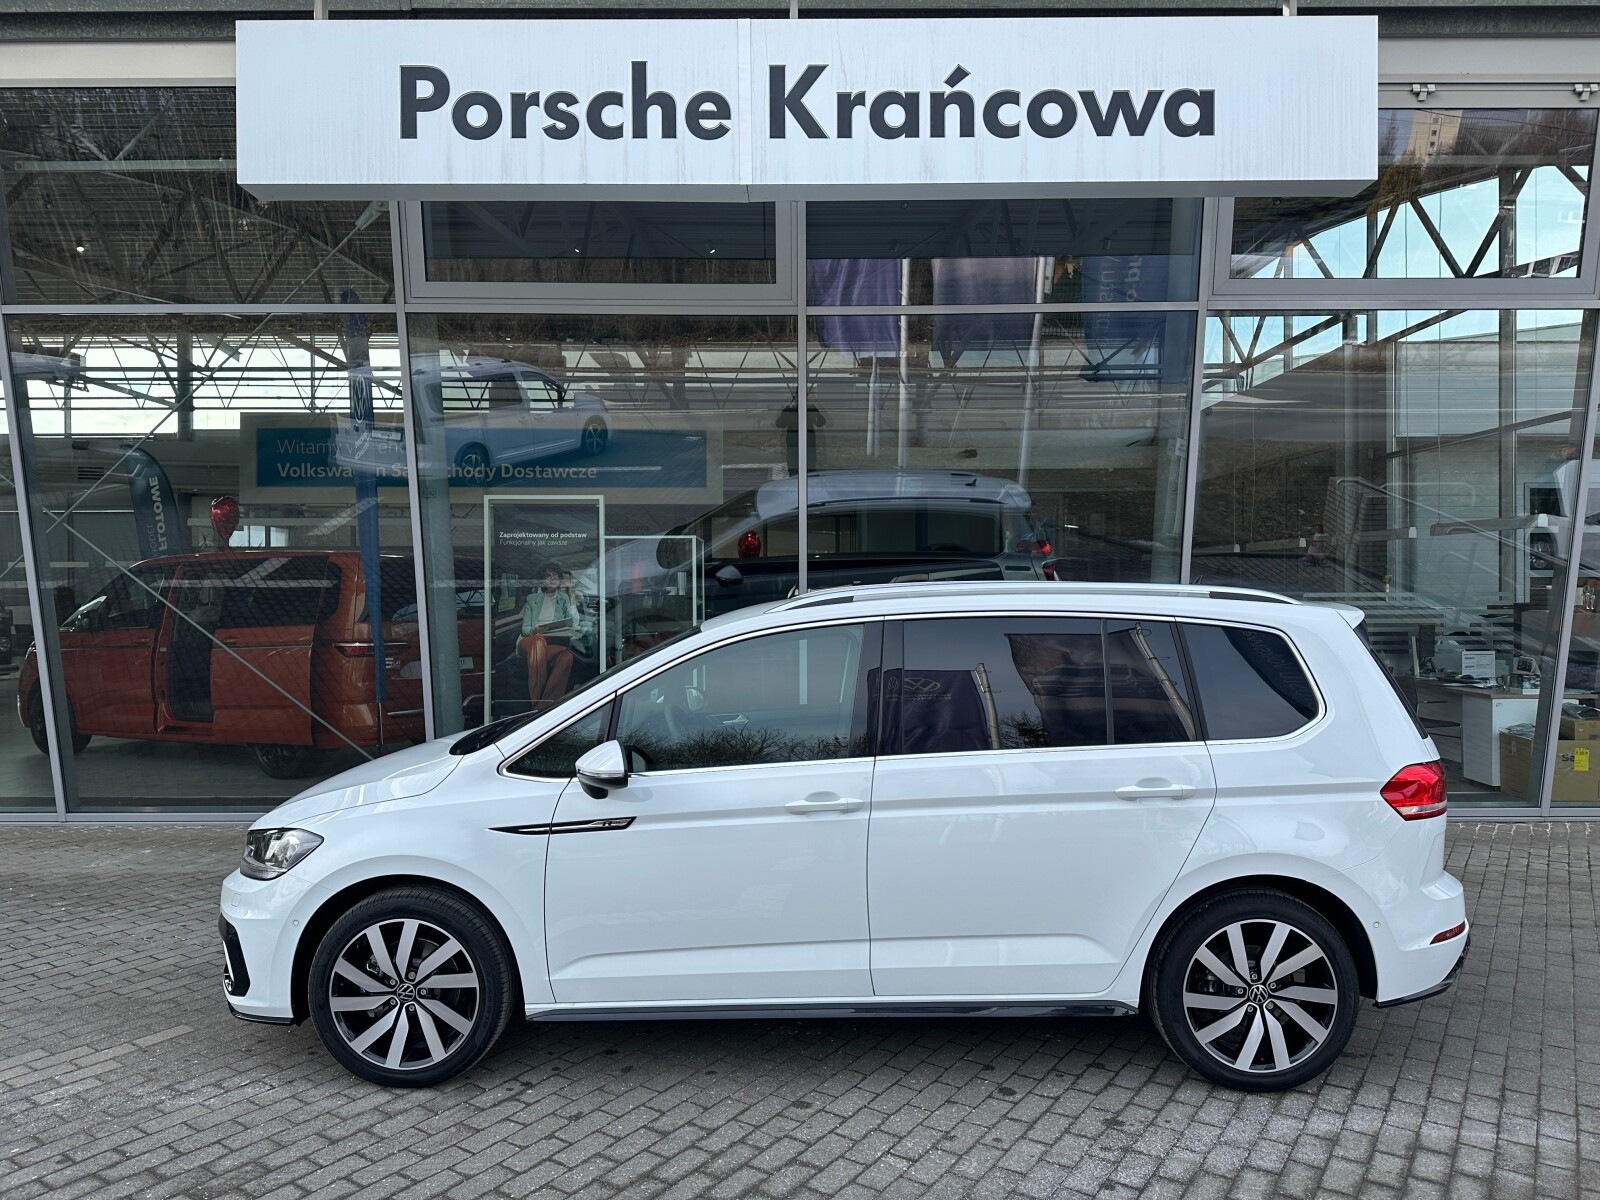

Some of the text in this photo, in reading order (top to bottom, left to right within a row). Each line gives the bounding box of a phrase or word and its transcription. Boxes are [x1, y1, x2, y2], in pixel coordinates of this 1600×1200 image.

[400, 61, 1216, 141] Porsche Krańcowa
[276, 439, 340, 458] Witamy
[501, 463, 597, 478] Dostawcze
[499, 531, 587, 540] Zaprojektowany od podstaw
